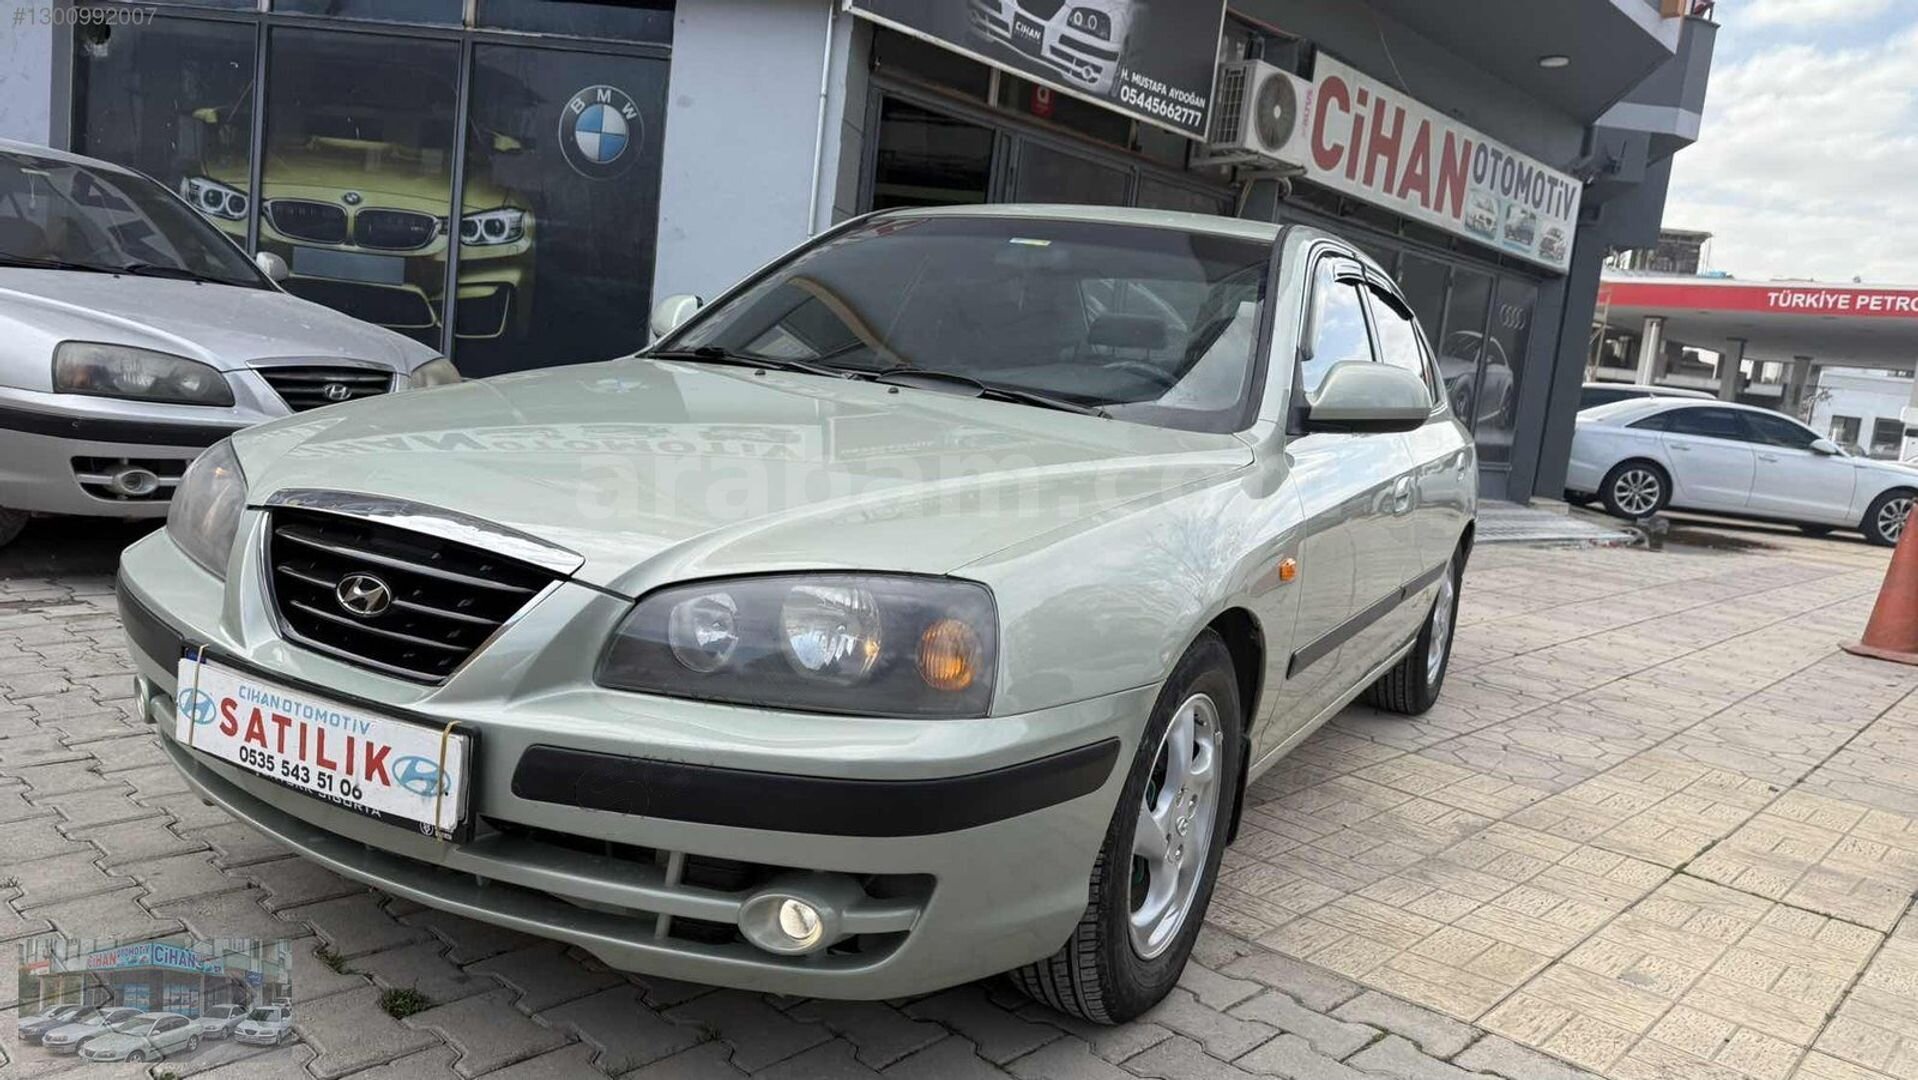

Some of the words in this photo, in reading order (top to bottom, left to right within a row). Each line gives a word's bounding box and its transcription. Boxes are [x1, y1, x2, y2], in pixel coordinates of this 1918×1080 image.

[1131, 72, 1167, 95] MUSTAFA
[570, 88, 637, 120] BMW
[1120, 85, 1202, 127] 05445662777
[1768, 290, 1851, 309] TÜRKİYE
[219, 697, 392, 787] SATILIK
[240, 745, 275, 772] 0535
[281, 760, 310, 783] 543
[317, 771, 333, 792] 51
[340, 779, 362, 800] 06
